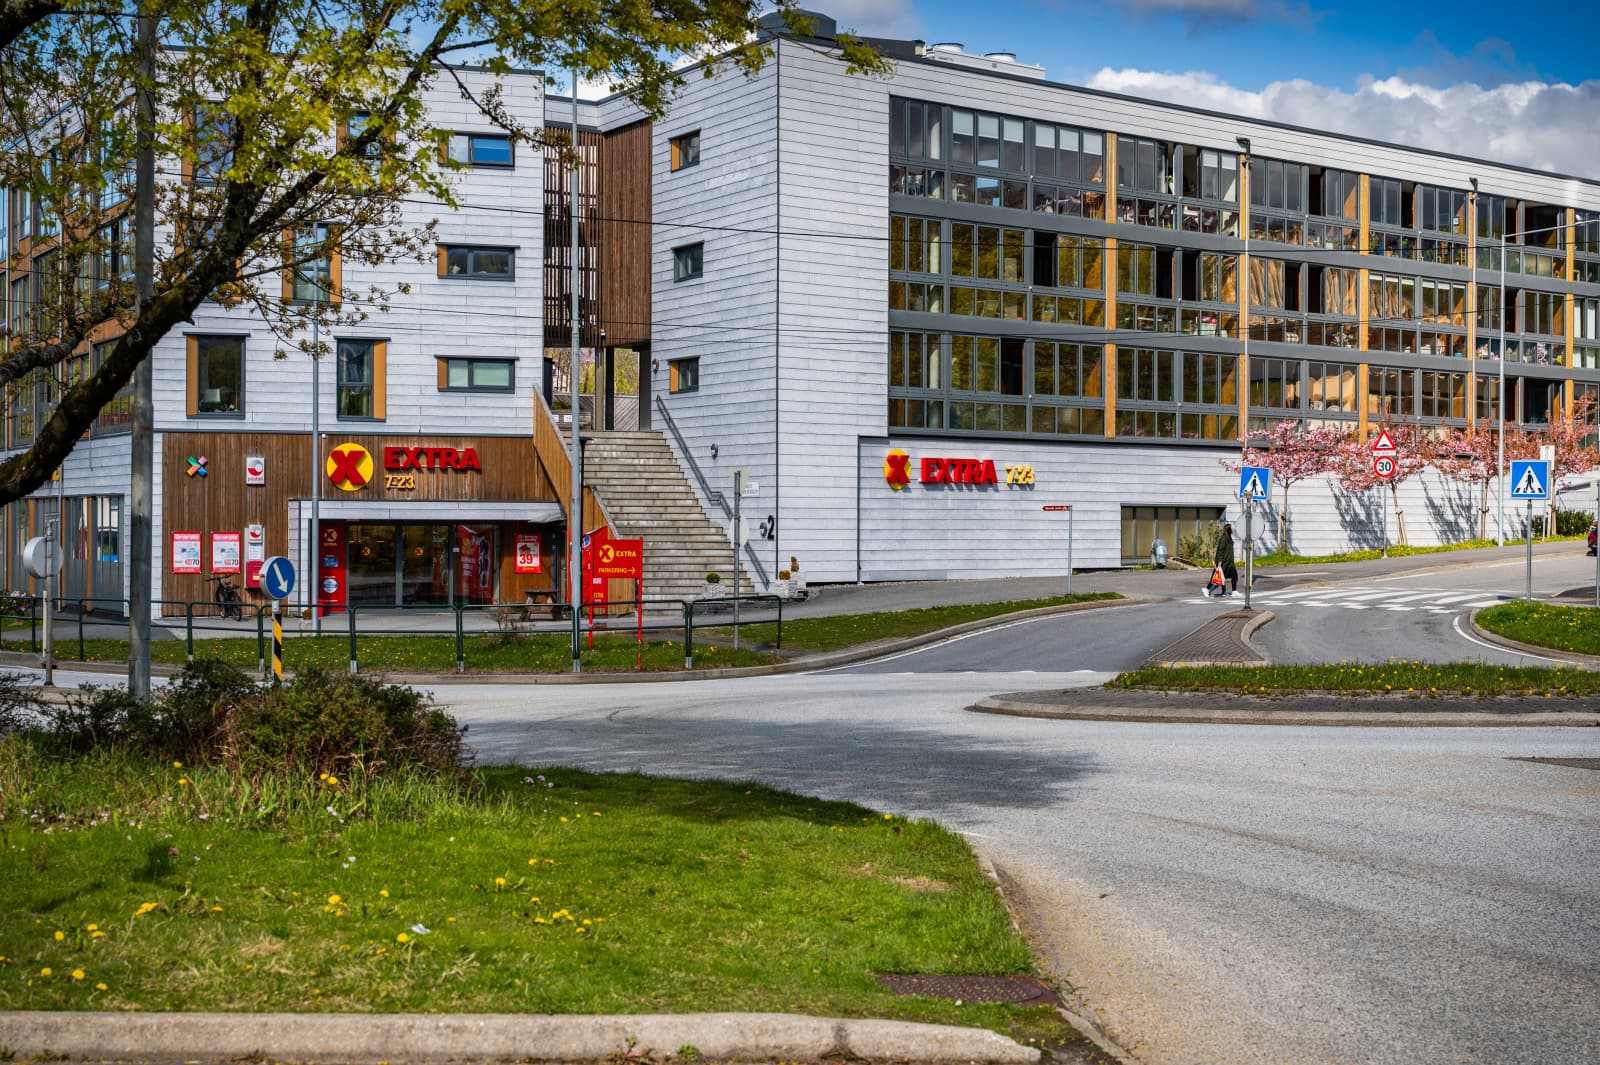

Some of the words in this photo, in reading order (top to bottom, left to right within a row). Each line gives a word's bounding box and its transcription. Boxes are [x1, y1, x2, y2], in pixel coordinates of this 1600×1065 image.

[330, 450, 367, 485] X
[384, 447, 481, 470] EXTRA
[886, 454, 911, 484] X
[921, 457, 998, 484] EXTRA
[1005, 464, 1035, 485] 7-23
[1378, 461, 1392, 472] 30
[385, 475, 415, 489] 7-23
[767, 514, 775, 541] 2
